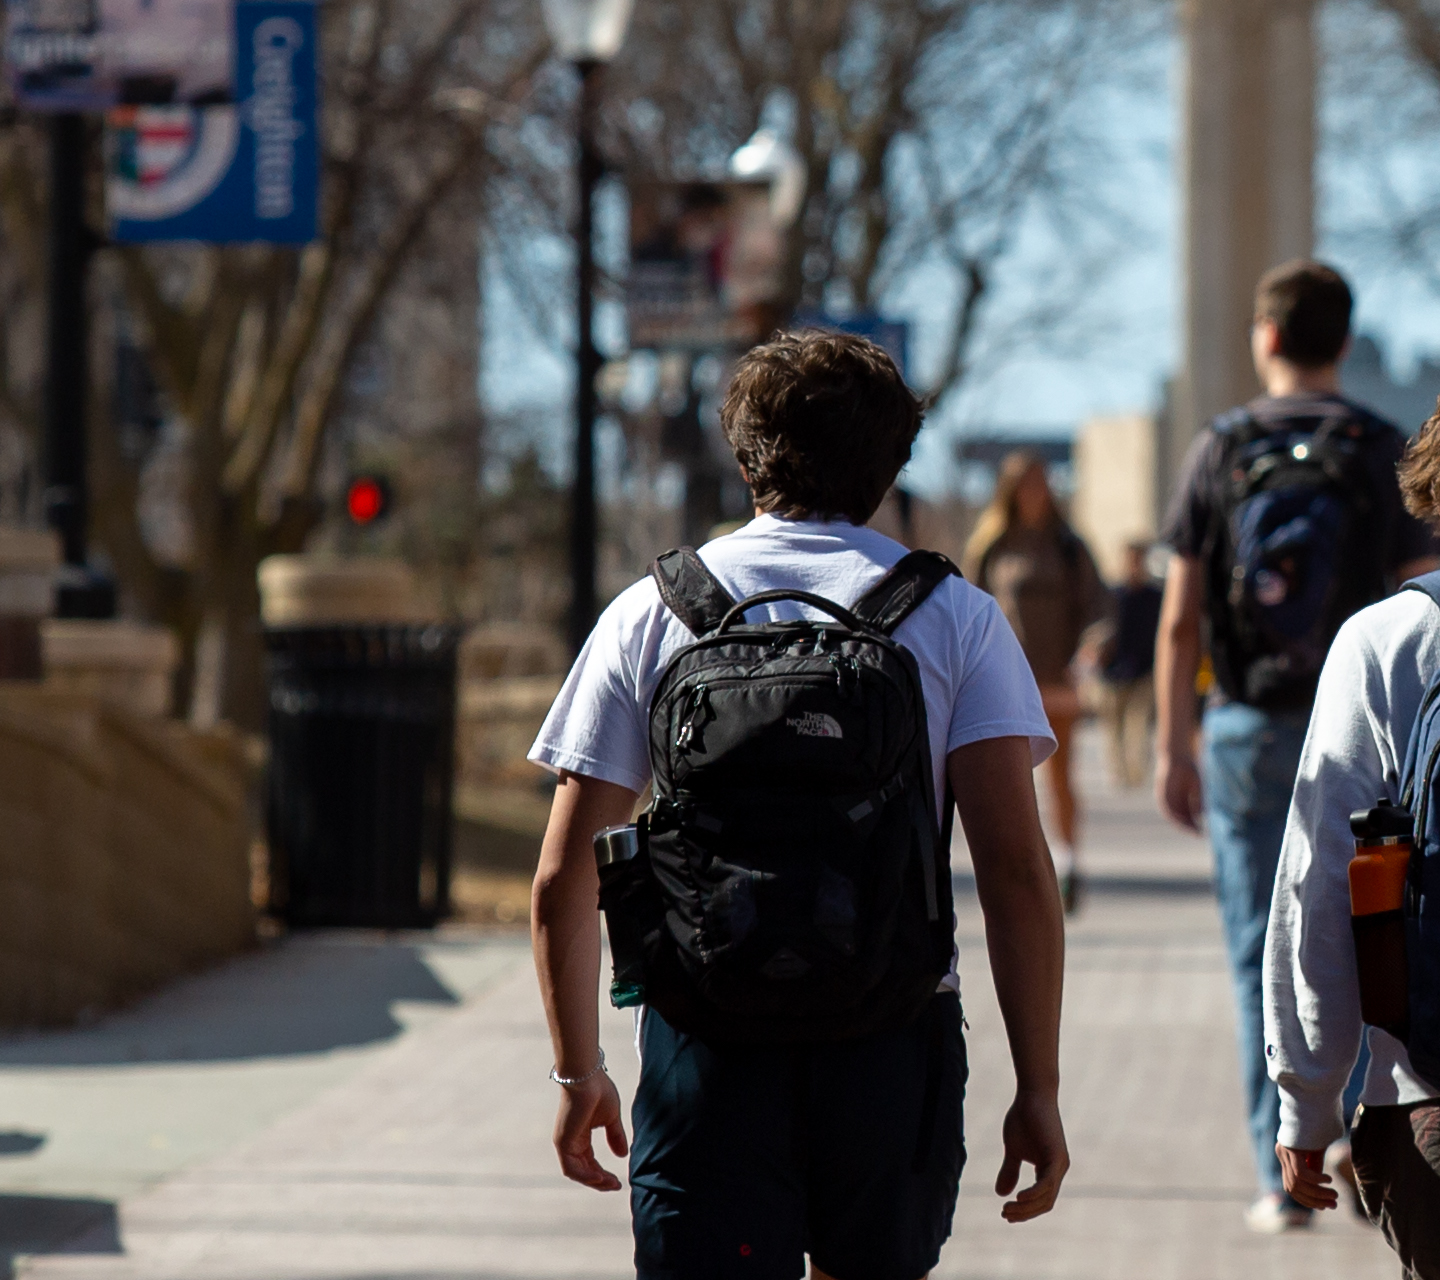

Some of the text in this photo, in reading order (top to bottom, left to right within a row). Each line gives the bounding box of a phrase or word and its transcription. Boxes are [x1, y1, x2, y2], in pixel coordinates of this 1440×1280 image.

[803, 711, 824, 721] THE
[786, 718, 824, 729] NORTH
[796, 726, 823, 737] FACE
